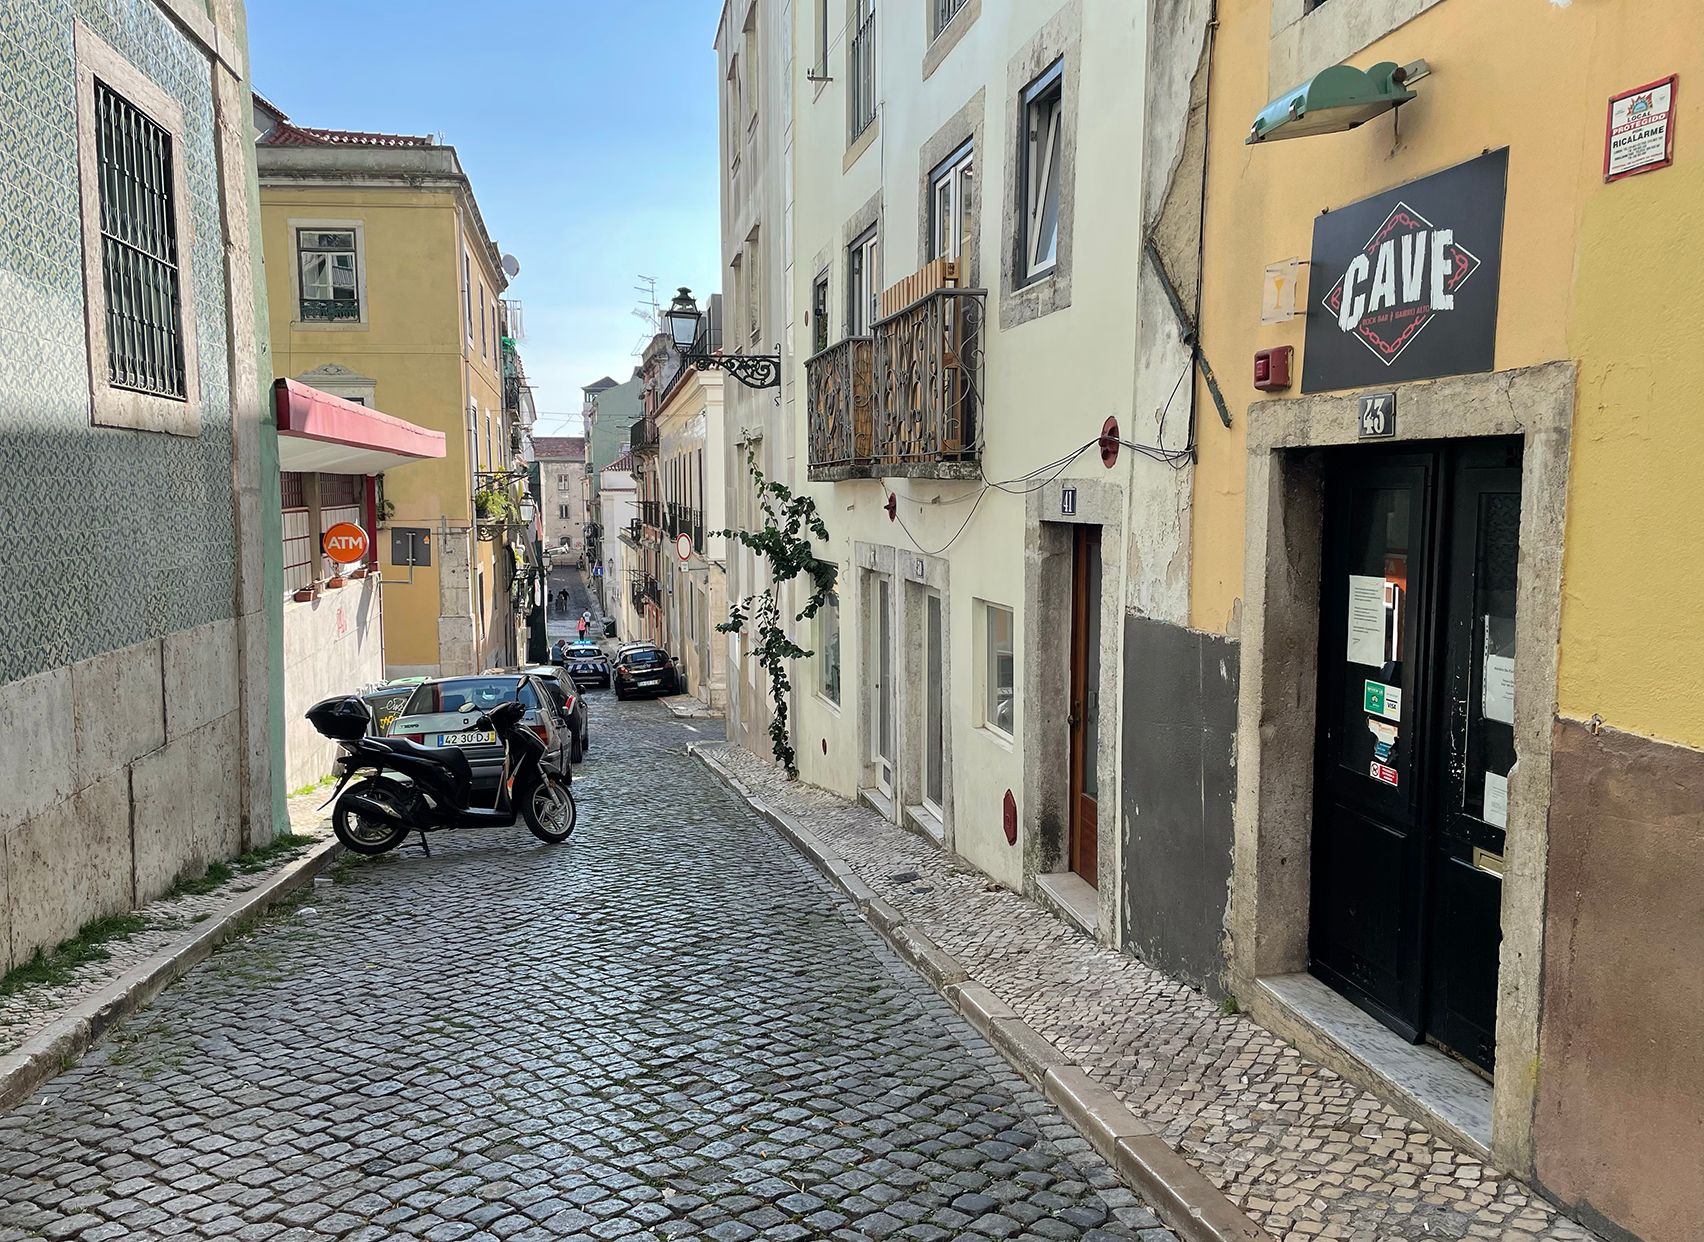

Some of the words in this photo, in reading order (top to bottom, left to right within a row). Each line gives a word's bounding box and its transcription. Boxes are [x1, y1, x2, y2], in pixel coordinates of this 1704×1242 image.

[1612, 113, 1666, 136] PROTEGIDO
[1627, 111, 1652, 122] LOCAL
[1613, 125, 1665, 149] RICALARME
[1338, 228, 1454, 332] CAVE
[1363, 397, 1386, 434] 43
[1062, 490, 1073, 512] 41
[327, 535, 363, 550] ATM
